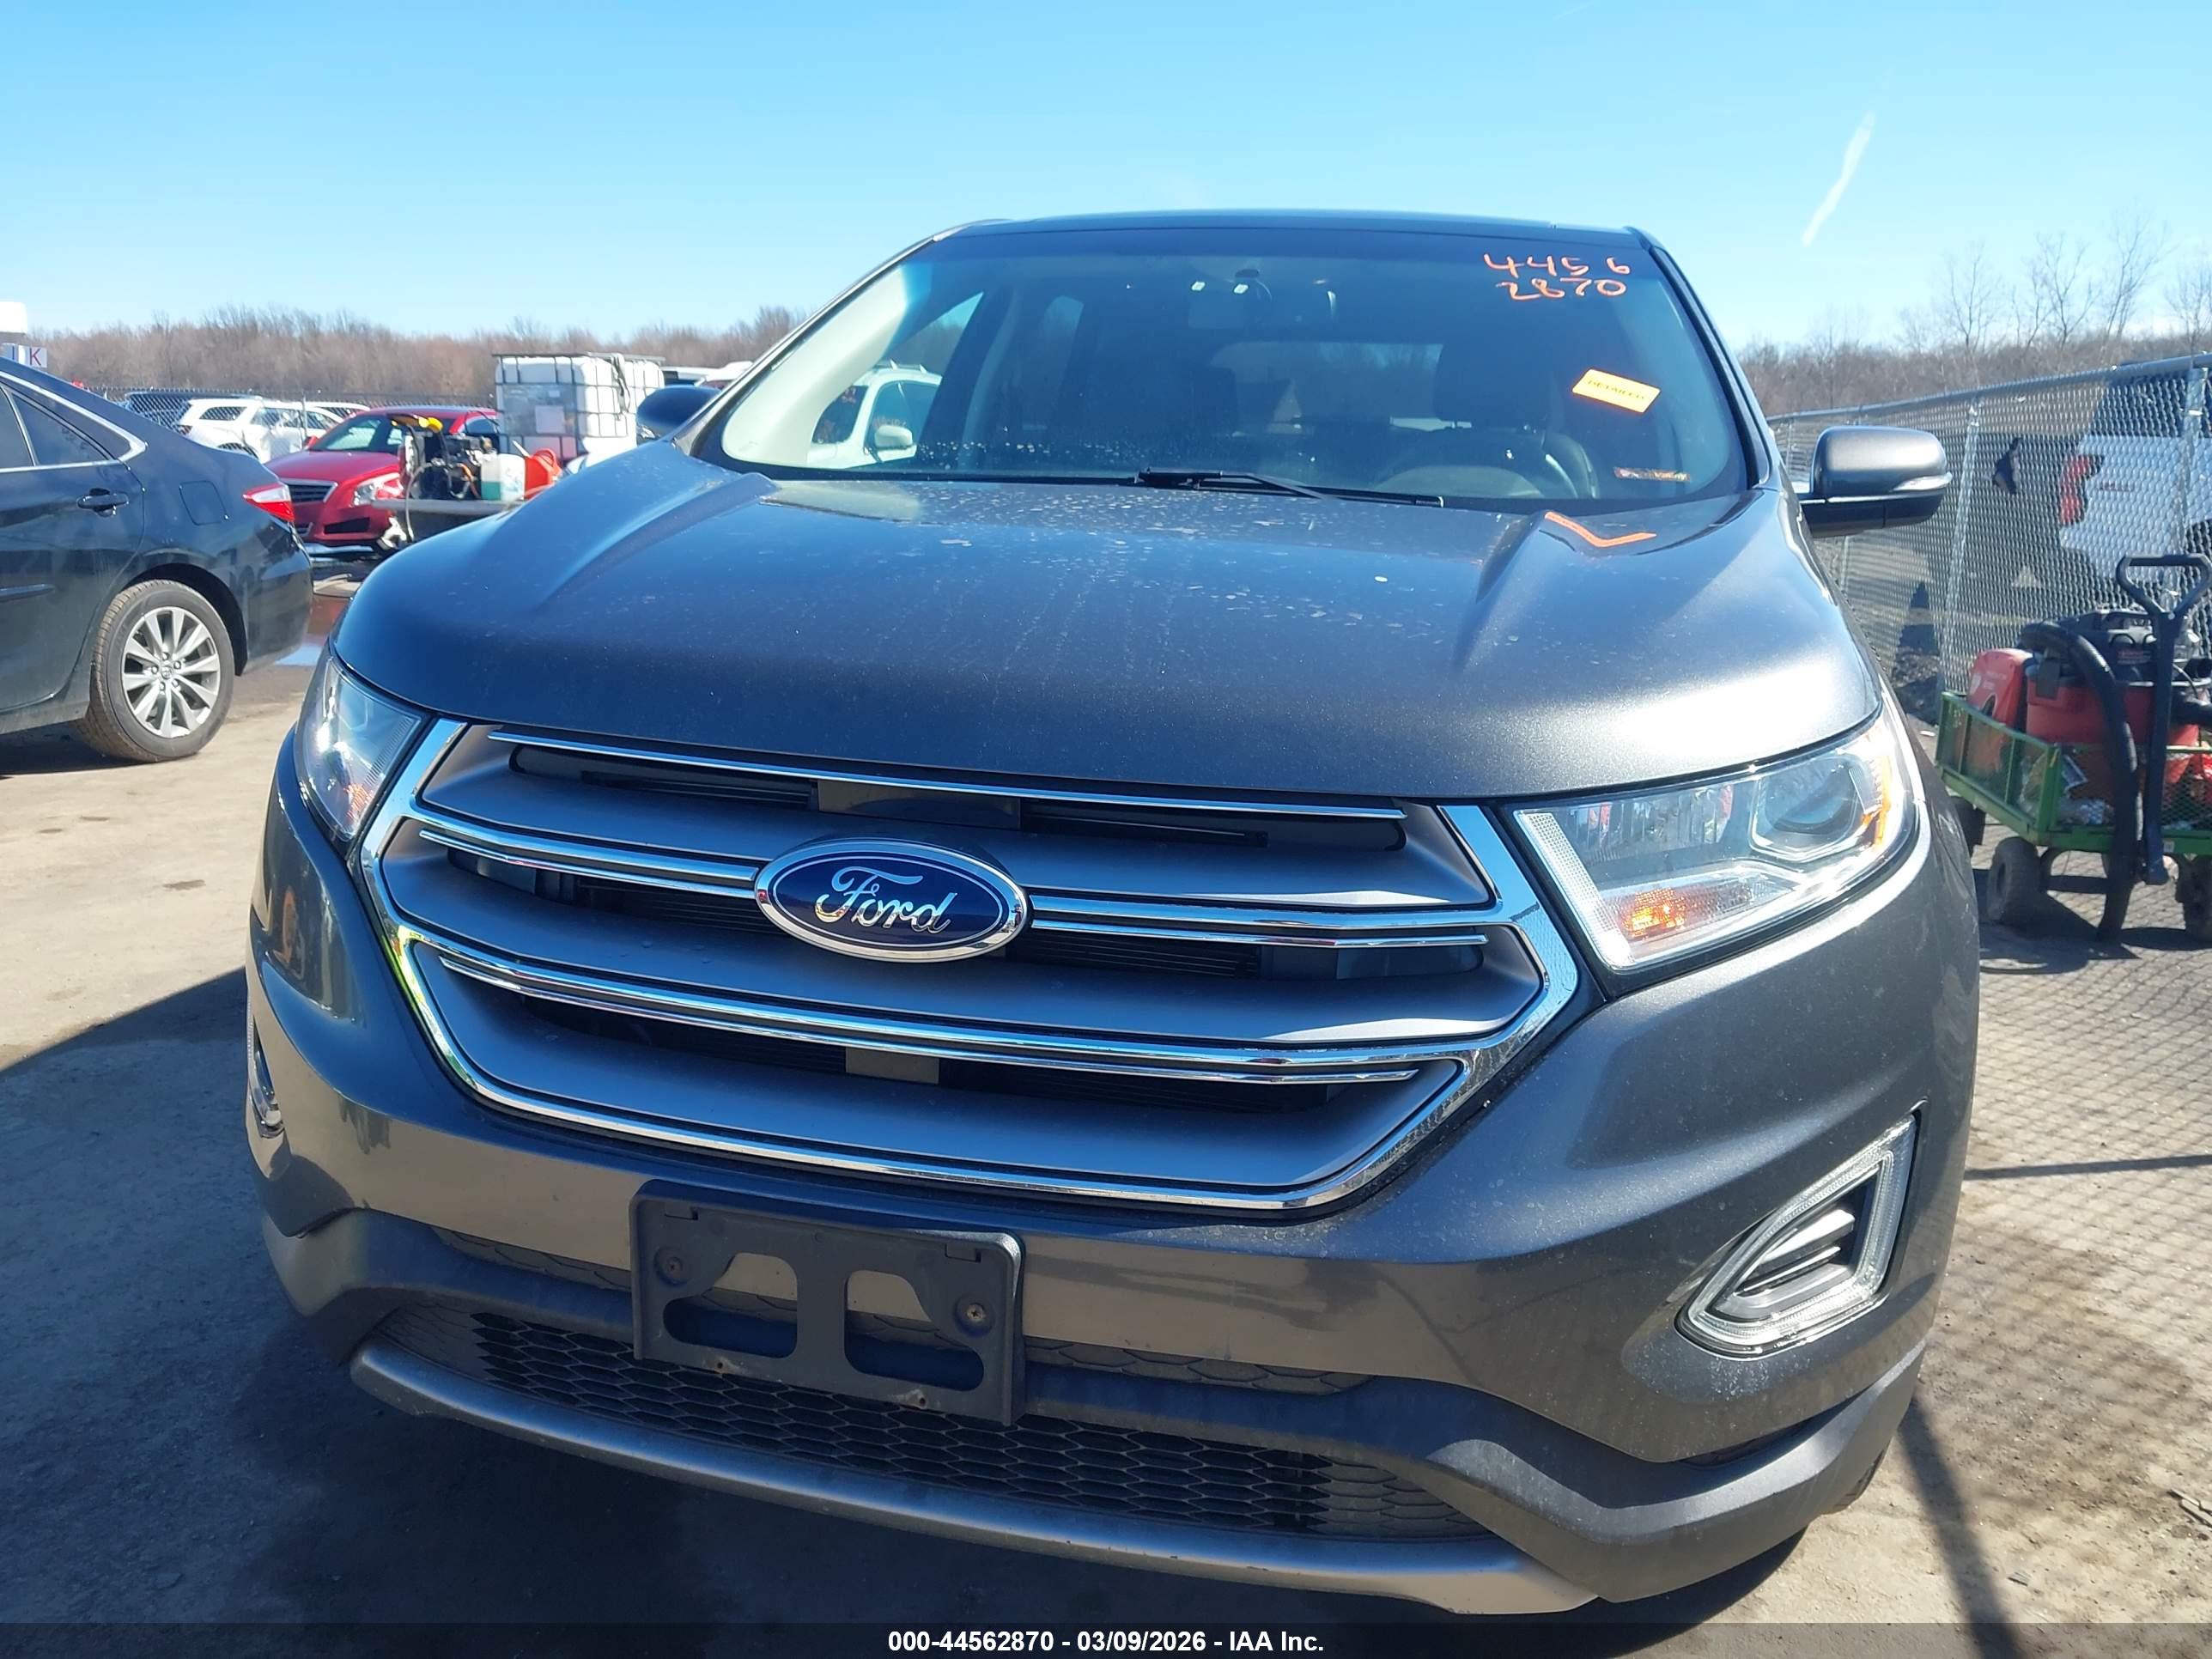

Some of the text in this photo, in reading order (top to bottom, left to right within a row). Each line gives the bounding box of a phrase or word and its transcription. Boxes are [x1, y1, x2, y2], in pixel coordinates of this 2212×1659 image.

[1483, 253, 1631, 278] 4456
[1495, 277, 1626, 300] 2870
[29, 347, 42, 366] K
[815, 866, 958, 934] Ford
